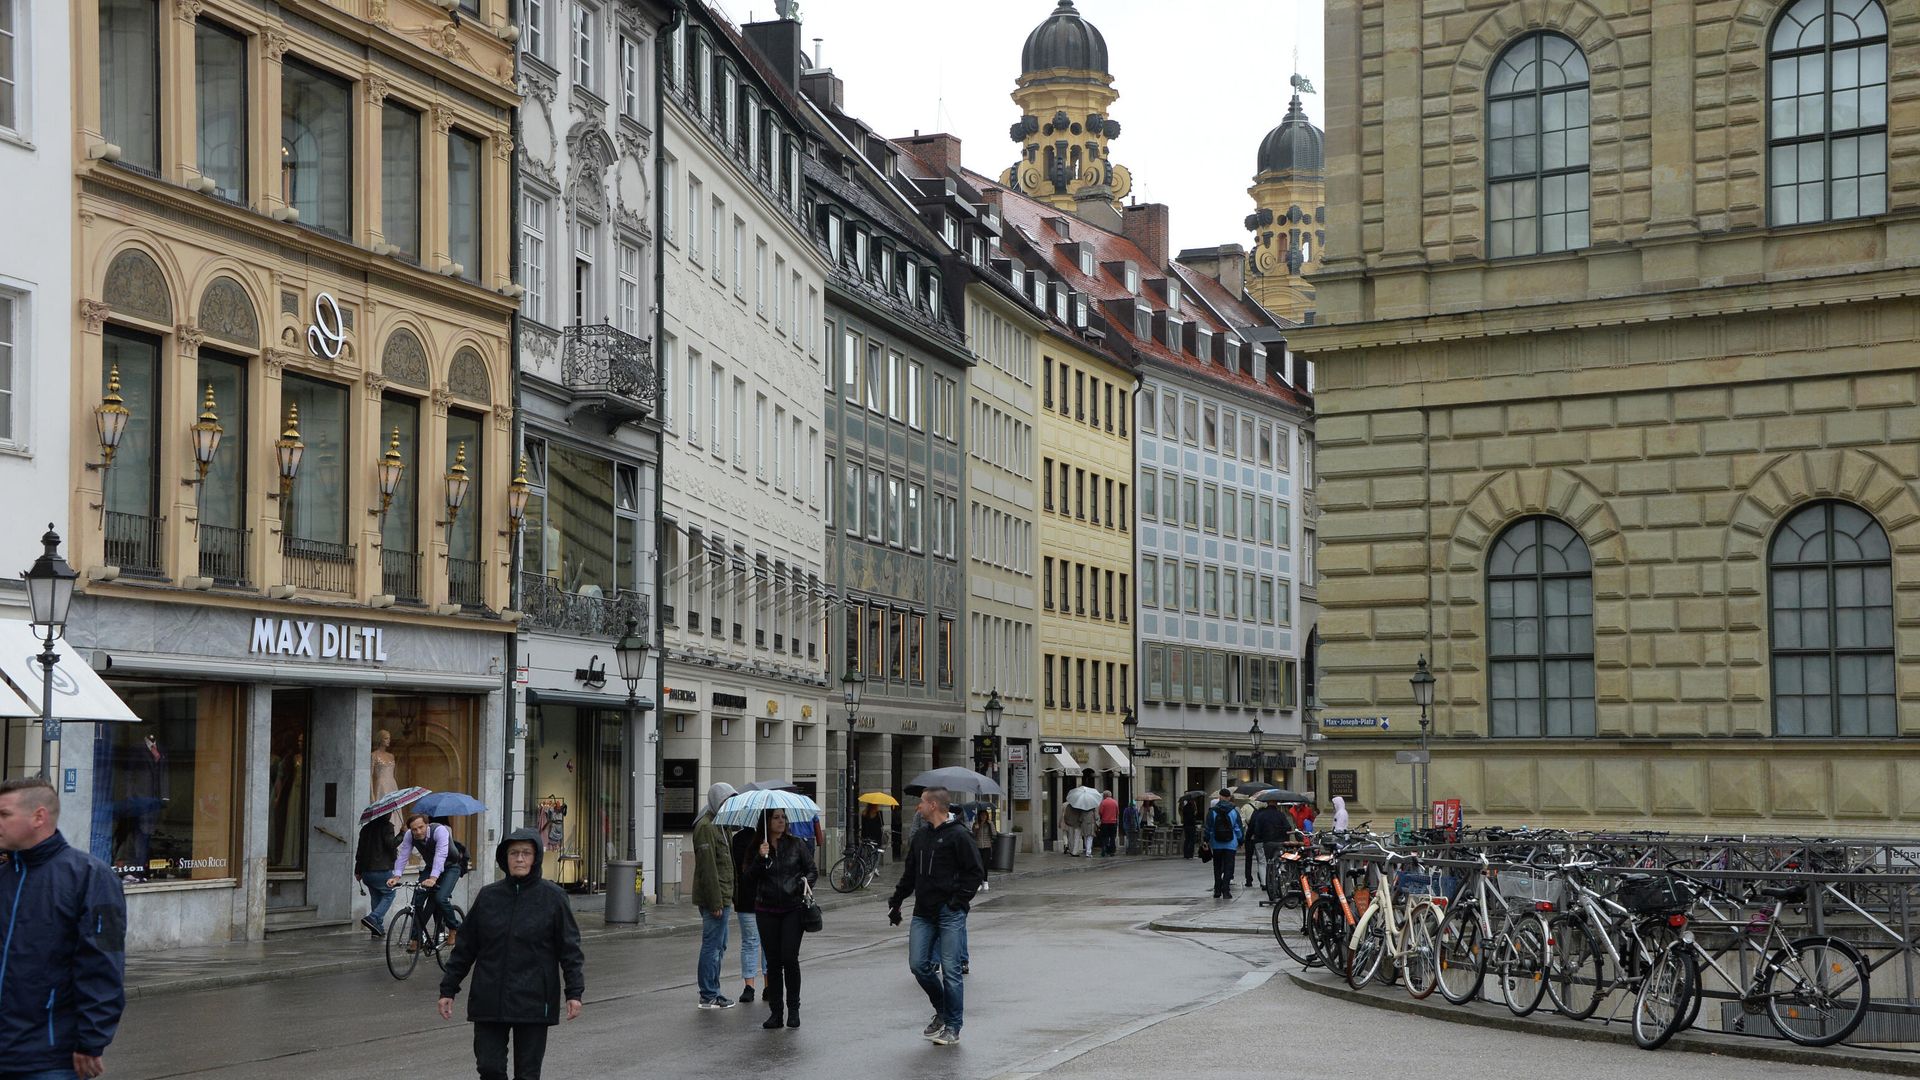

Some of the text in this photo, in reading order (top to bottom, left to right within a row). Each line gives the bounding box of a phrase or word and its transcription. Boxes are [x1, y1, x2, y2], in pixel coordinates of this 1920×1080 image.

[251, 617, 387, 661] MAX DIETL
[67, 770, 75, 782] 16
[179, 857, 208, 869] STEFANO
[208, 856, 227, 868] RICCI
